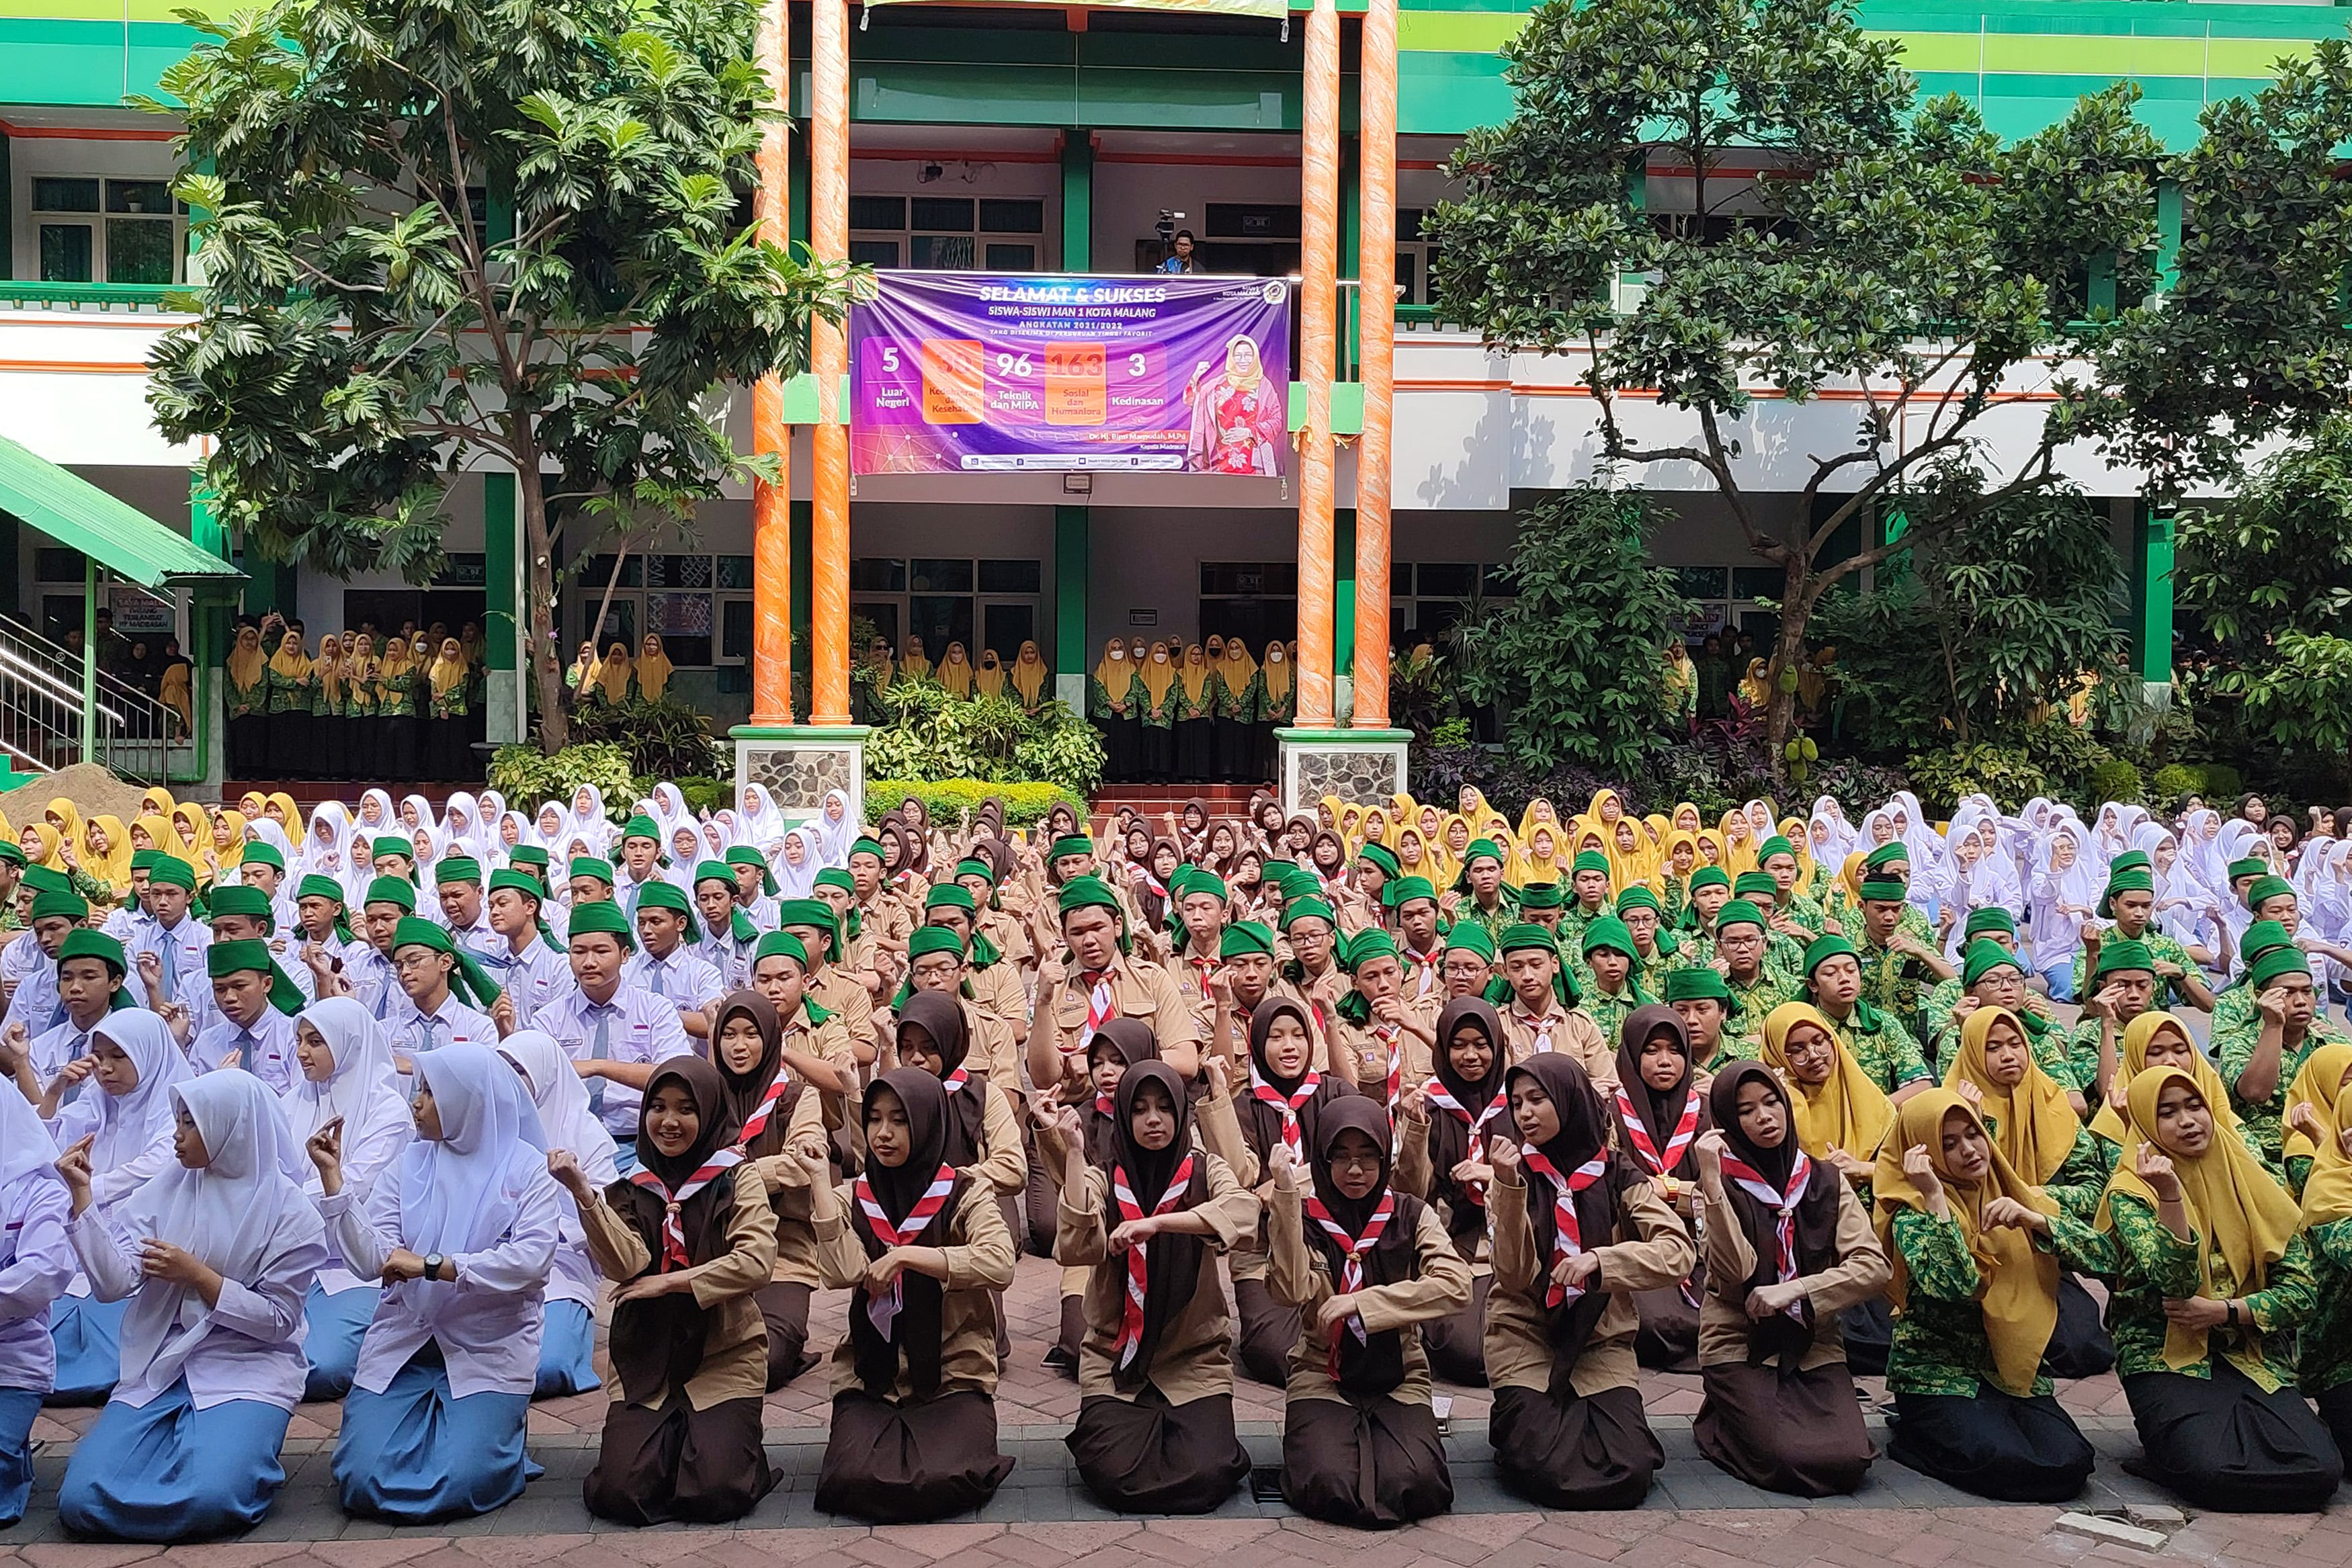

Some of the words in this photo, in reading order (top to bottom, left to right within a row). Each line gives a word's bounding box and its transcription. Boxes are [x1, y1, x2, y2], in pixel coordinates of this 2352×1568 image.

[979, 286, 1071, 302] SELAMAT
[1075, 288, 1089, 302] &
[1093, 288, 1167, 302] SUKSES
[988, 305, 1052, 317] SISWA-SISWI
[1052, 307, 1075, 318] MAN
[1077, 308, 1084, 317] 1
[1085, 308, 1111, 318] KOTA
[1113, 307, 1156, 318] MALANG
[1019, 320, 1070, 329] ANGKATAN
[1073, 321, 1123, 330] 2021/2022
[882, 347, 900, 372] 5
[1050, 353, 1103, 376] 163
[1128, 353, 1146, 377] 3
[997, 353, 1034, 378] 96
[882, 386, 905, 397] Luar
[997, 390, 1032, 400] Teknik
[1063, 389, 1089, 398] Sosial
[876, 396, 909, 409] Negeri
[991, 400, 1010, 409] dan
[1011, 401, 1039, 410] MIPA
[1067, 398, 1084, 406] dan
[1111, 396, 1164, 406] Kedinasan
[1051, 407, 1101, 416] Humaniora
